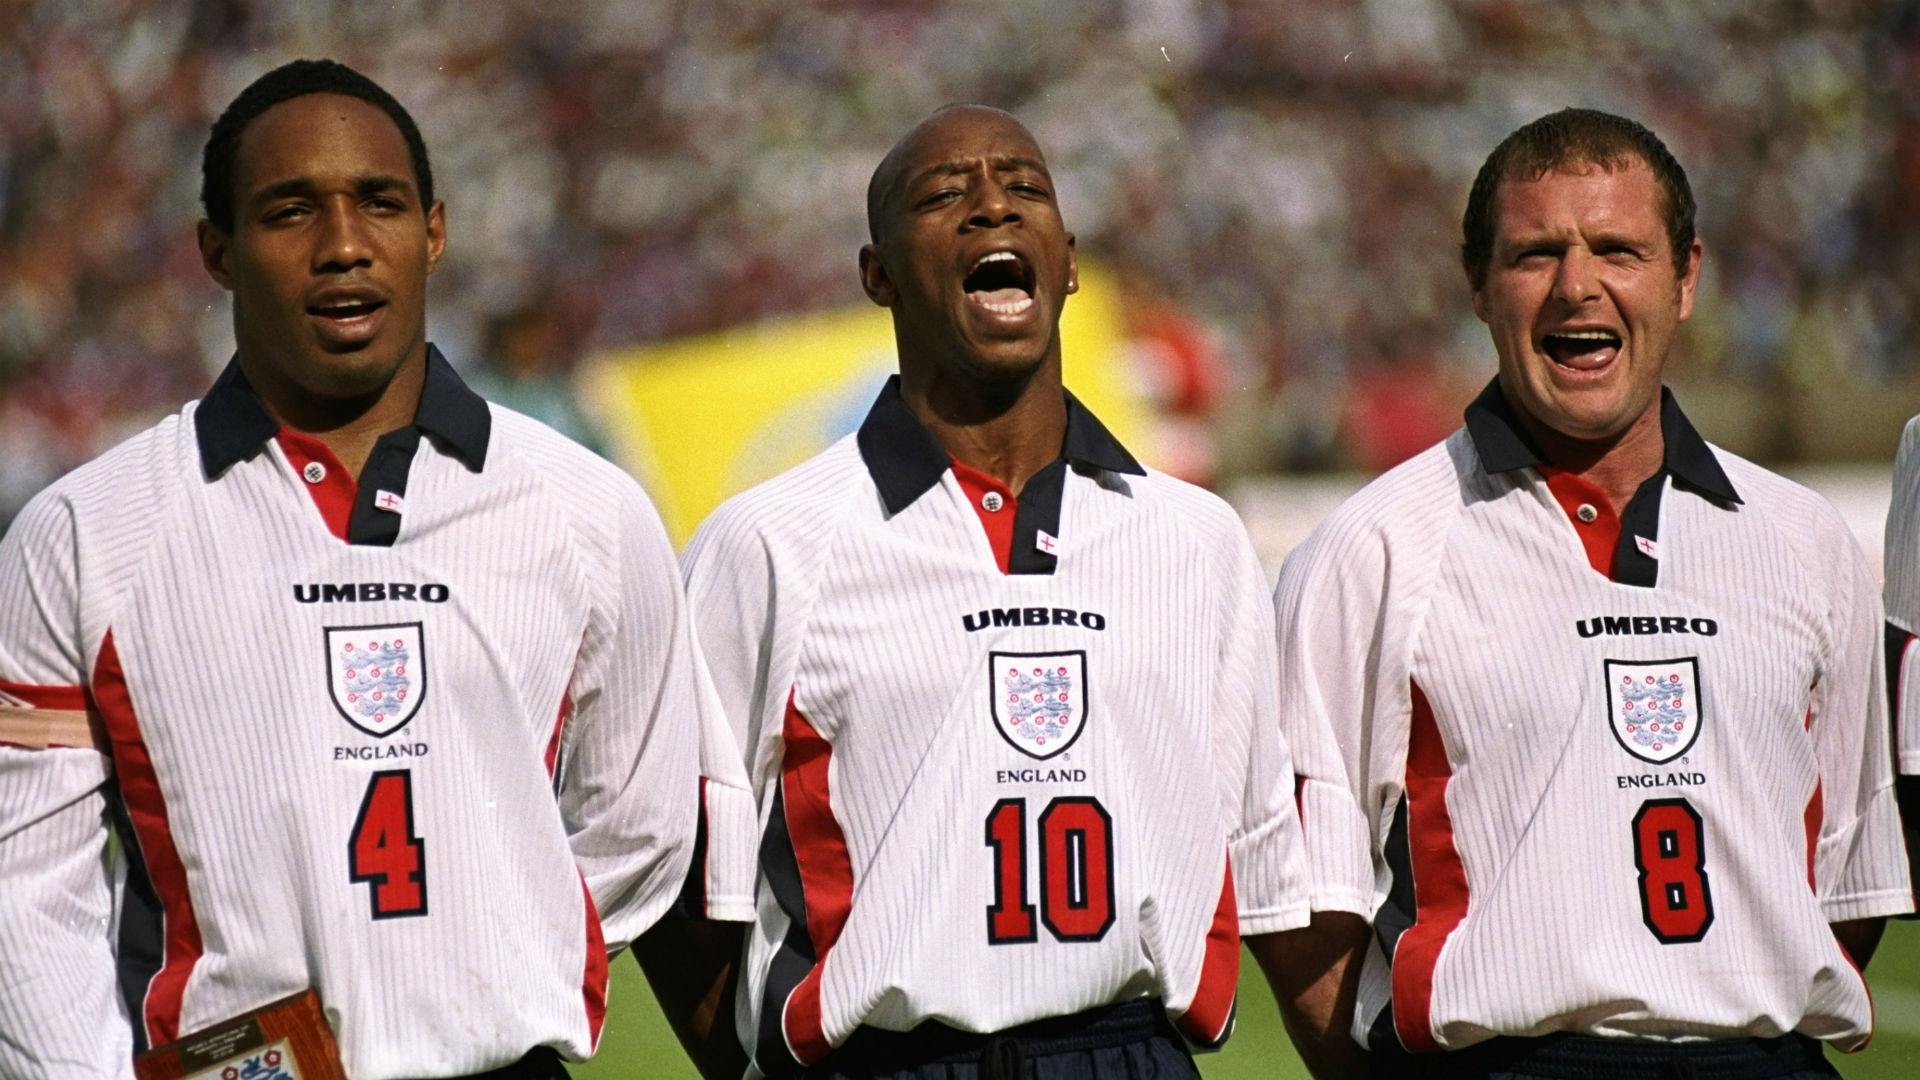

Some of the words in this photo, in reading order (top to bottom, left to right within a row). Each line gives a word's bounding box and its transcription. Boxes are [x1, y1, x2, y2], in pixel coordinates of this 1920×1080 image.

[293, 583, 450, 604] UMBRO
[961, 607, 1106, 632] UMBRO
[1576, 616, 1719, 638] UMBRO
[333, 743, 428, 761] ENGLAND
[996, 769, 1087, 784] ENGLAND
[1616, 772, 1706, 789] ENGLAND
[347, 768, 429, 921] 4
[985, 795, 1117, 946] 10
[1631, 797, 1715, 945] 8
